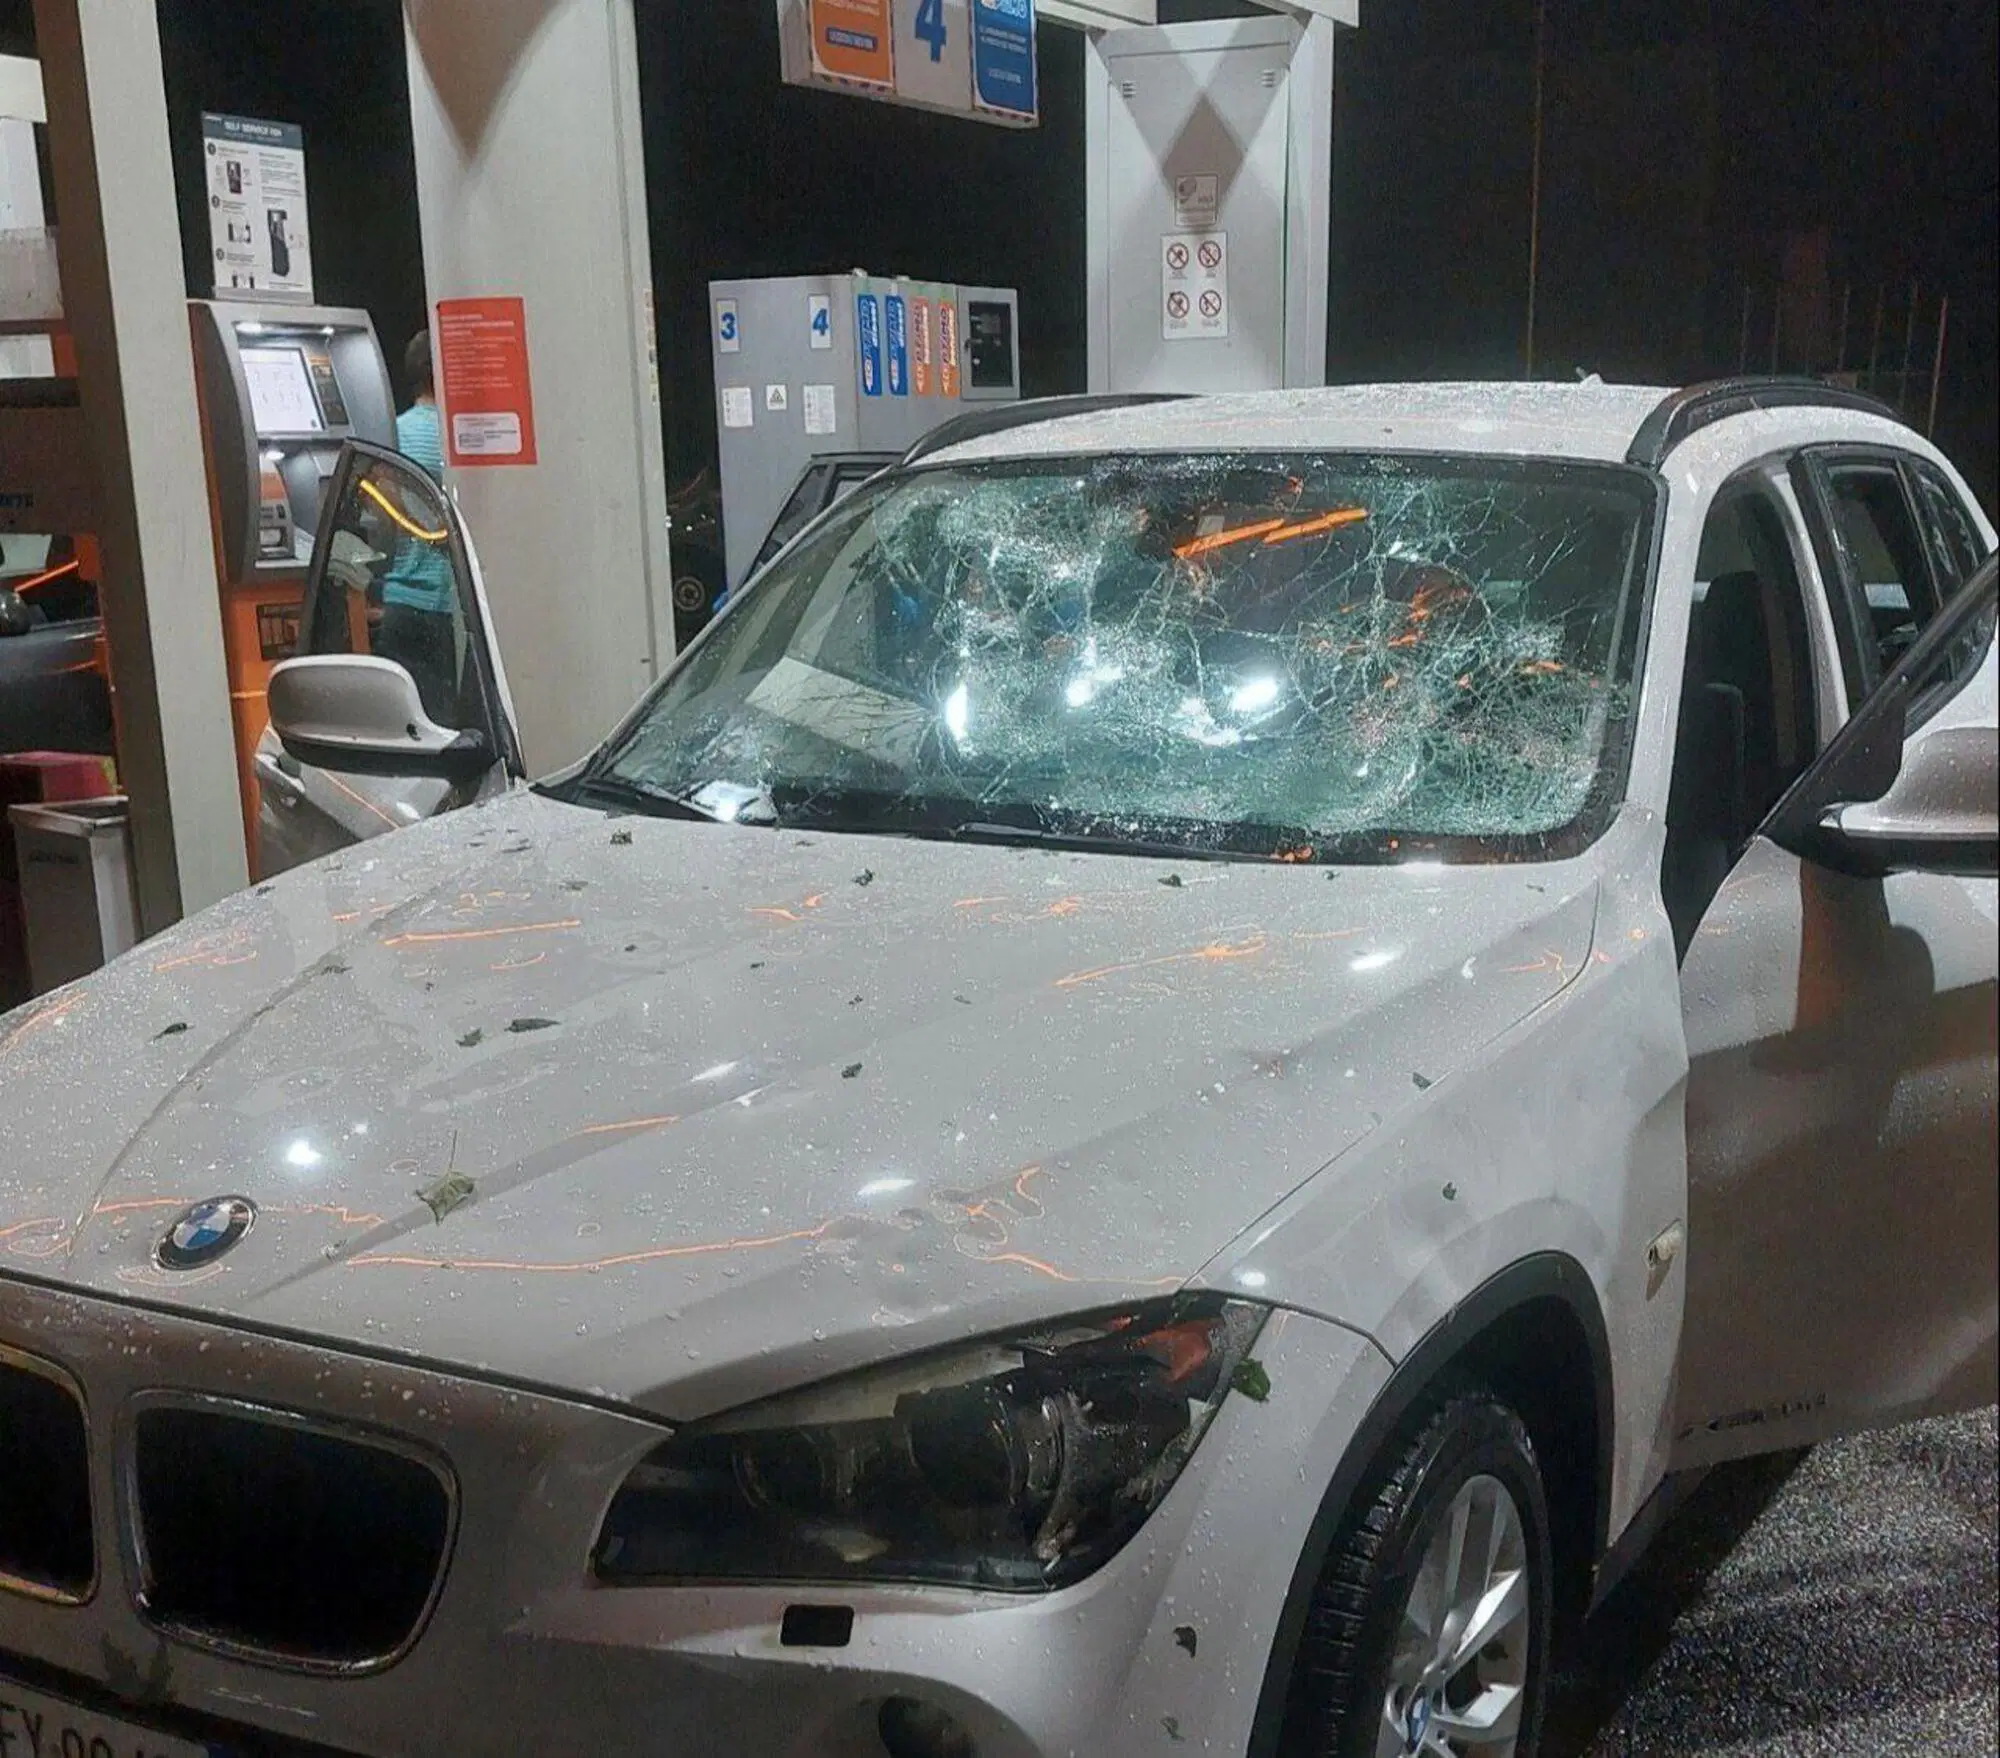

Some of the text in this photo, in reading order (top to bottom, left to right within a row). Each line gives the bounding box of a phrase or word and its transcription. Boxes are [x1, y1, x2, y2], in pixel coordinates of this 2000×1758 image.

[915, 0, 946, 63] 4
[720, 311, 736, 340] 3
[812, 308, 829, 336] 4
